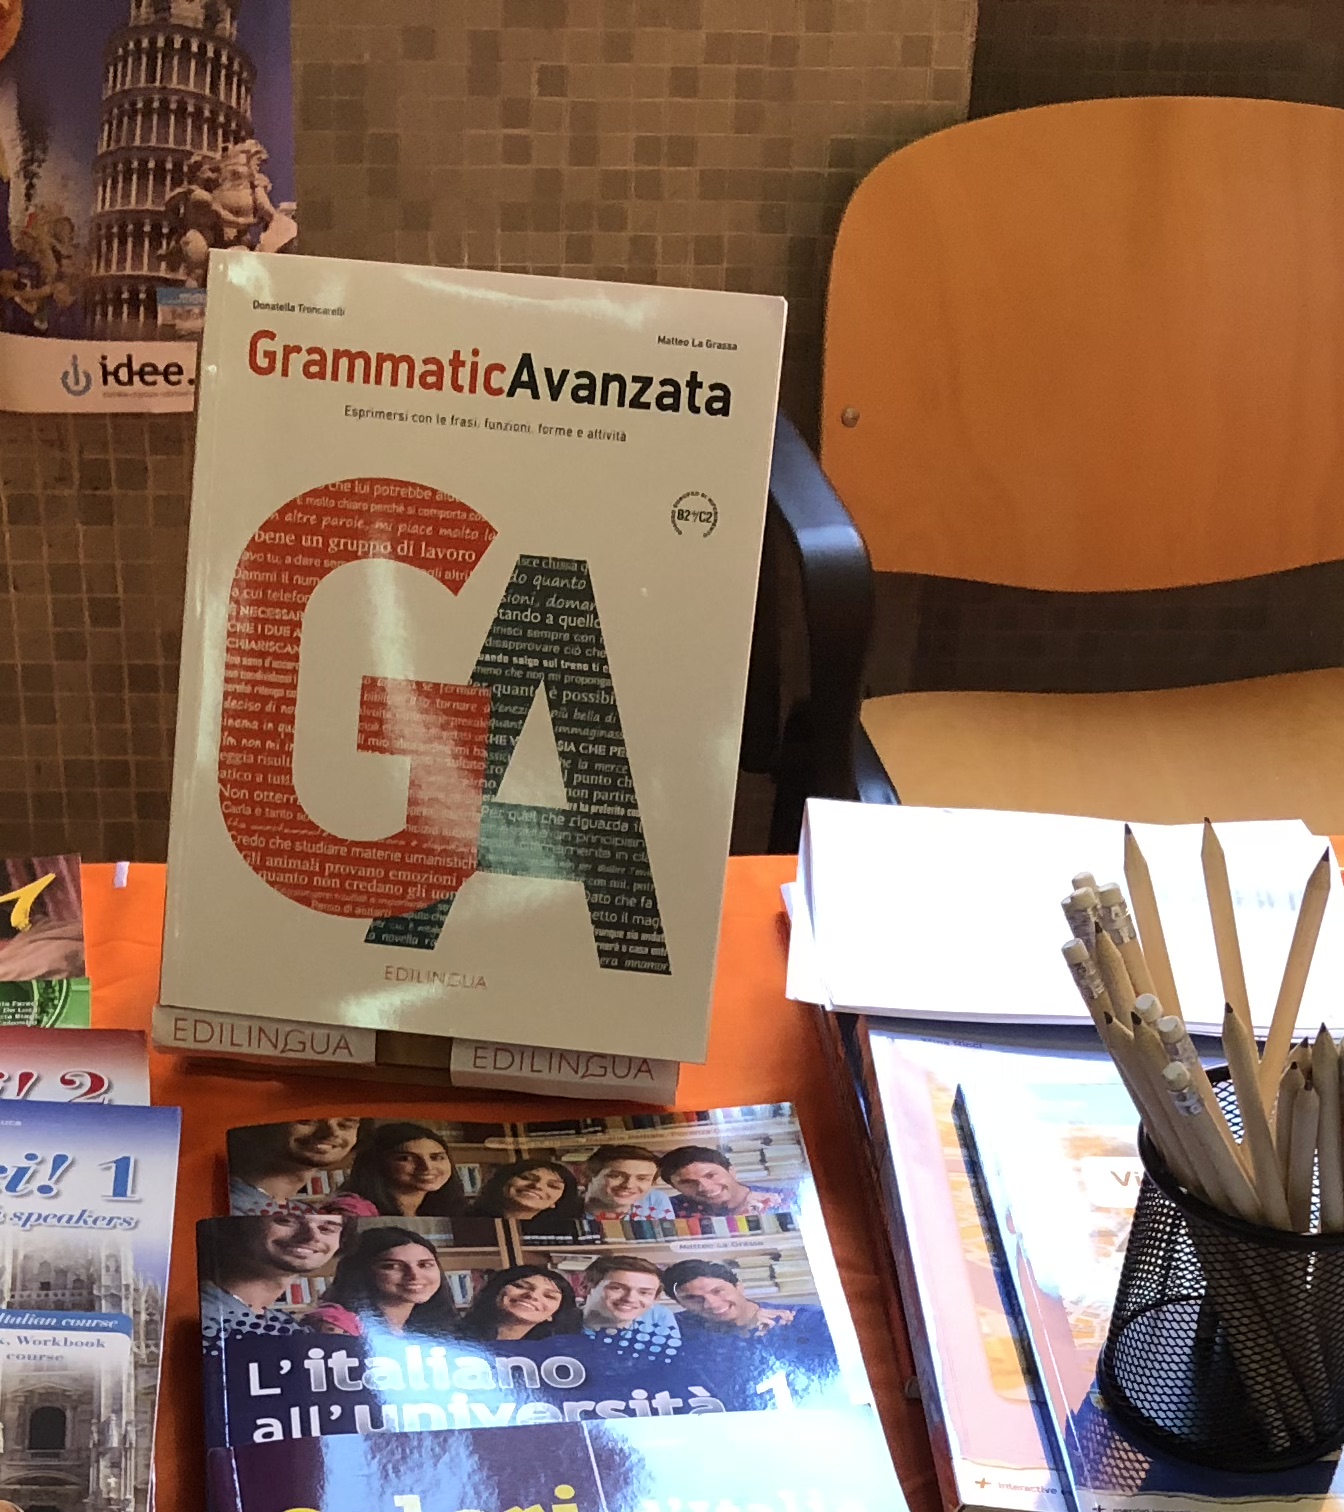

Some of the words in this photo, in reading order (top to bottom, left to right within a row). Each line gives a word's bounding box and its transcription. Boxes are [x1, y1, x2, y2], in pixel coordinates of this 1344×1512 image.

[252, 300, 296, 314] Donatella
[657, 335, 689, 349] Matteo
[705, 339, 738, 351] Grassa
[344, 404, 408, 422] Esprimersi
[538, 422, 574, 438] forme
[587, 427, 627, 443] attività
[383, 965, 488, 990] EDILINGUA
[173, 1016, 354, 1058] EDILINGUA
[472, 1046, 656, 1082] EDILINGUA
[96, 1155, 142, 1201] 1
[10, 1206, 138, 1229] speakers
[15, 1335, 105, 1351] Workbook
[248, 1348, 586, 1399] L'italiano
